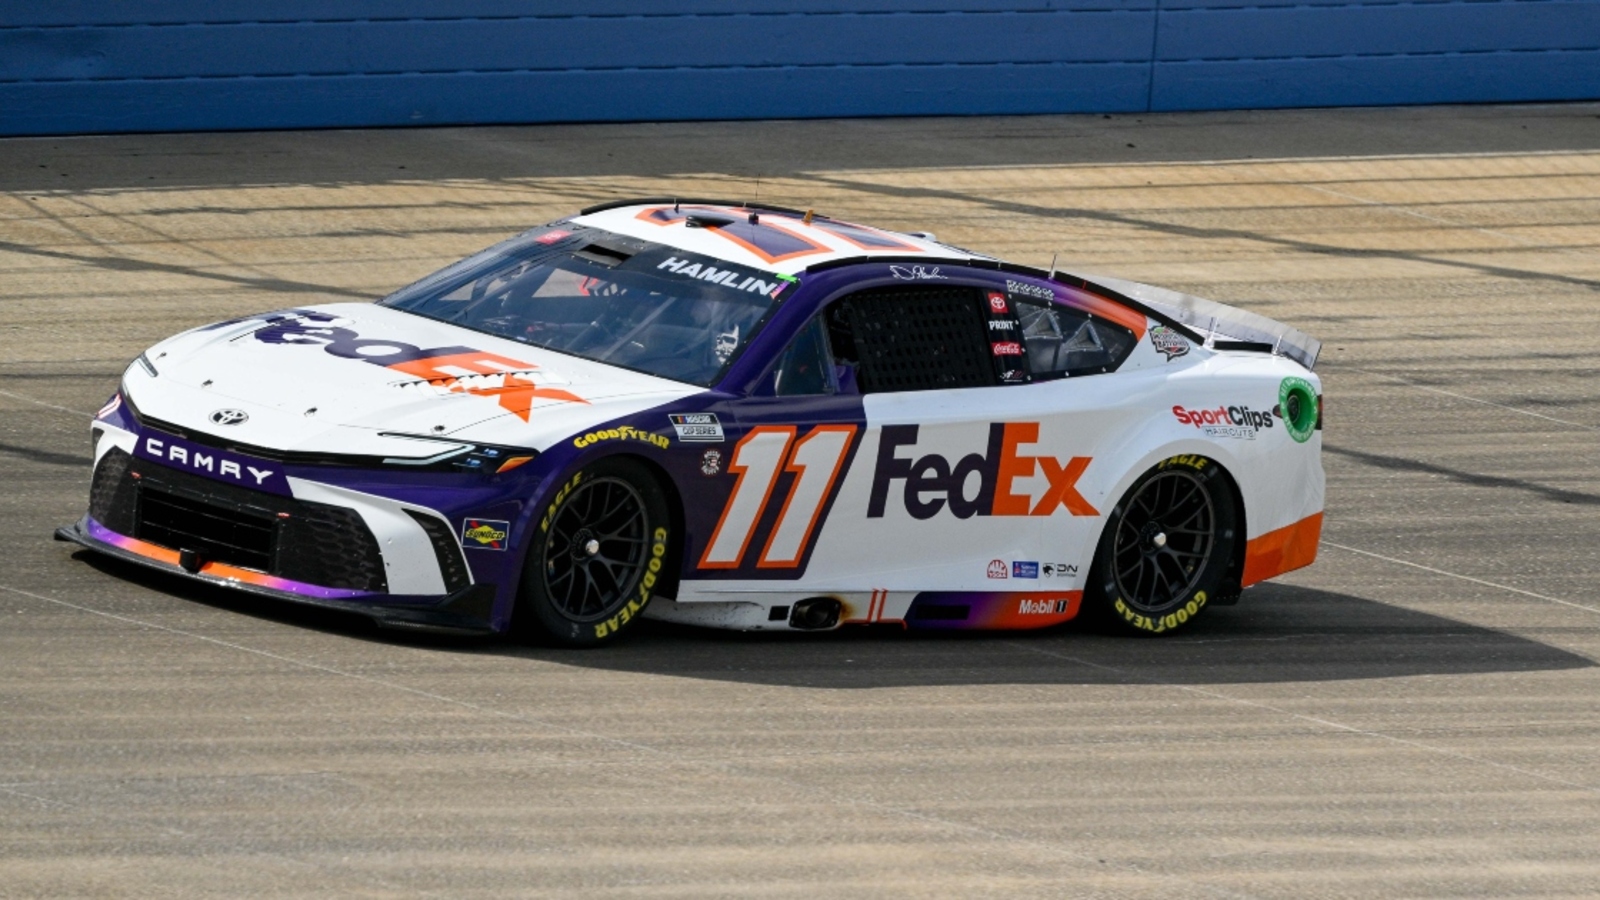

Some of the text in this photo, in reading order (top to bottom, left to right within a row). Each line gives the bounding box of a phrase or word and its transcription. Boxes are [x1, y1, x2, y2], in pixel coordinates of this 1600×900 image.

[656, 257, 777, 297] HAMLIN
[573, 426, 670, 450] GOODYEAR
[146, 437, 274, 485] CAMRY
[867, 421, 1101, 521] FedEx
[541, 470, 583, 533] EAGLE
[696, 424, 858, 569] 11
[465, 528, 505, 540] SUNOCO
[594, 526, 668, 639] GOODYEAR
[1018, 600, 1054, 615] Mobil
[1115, 590, 1208, 633] GOODYEAR
